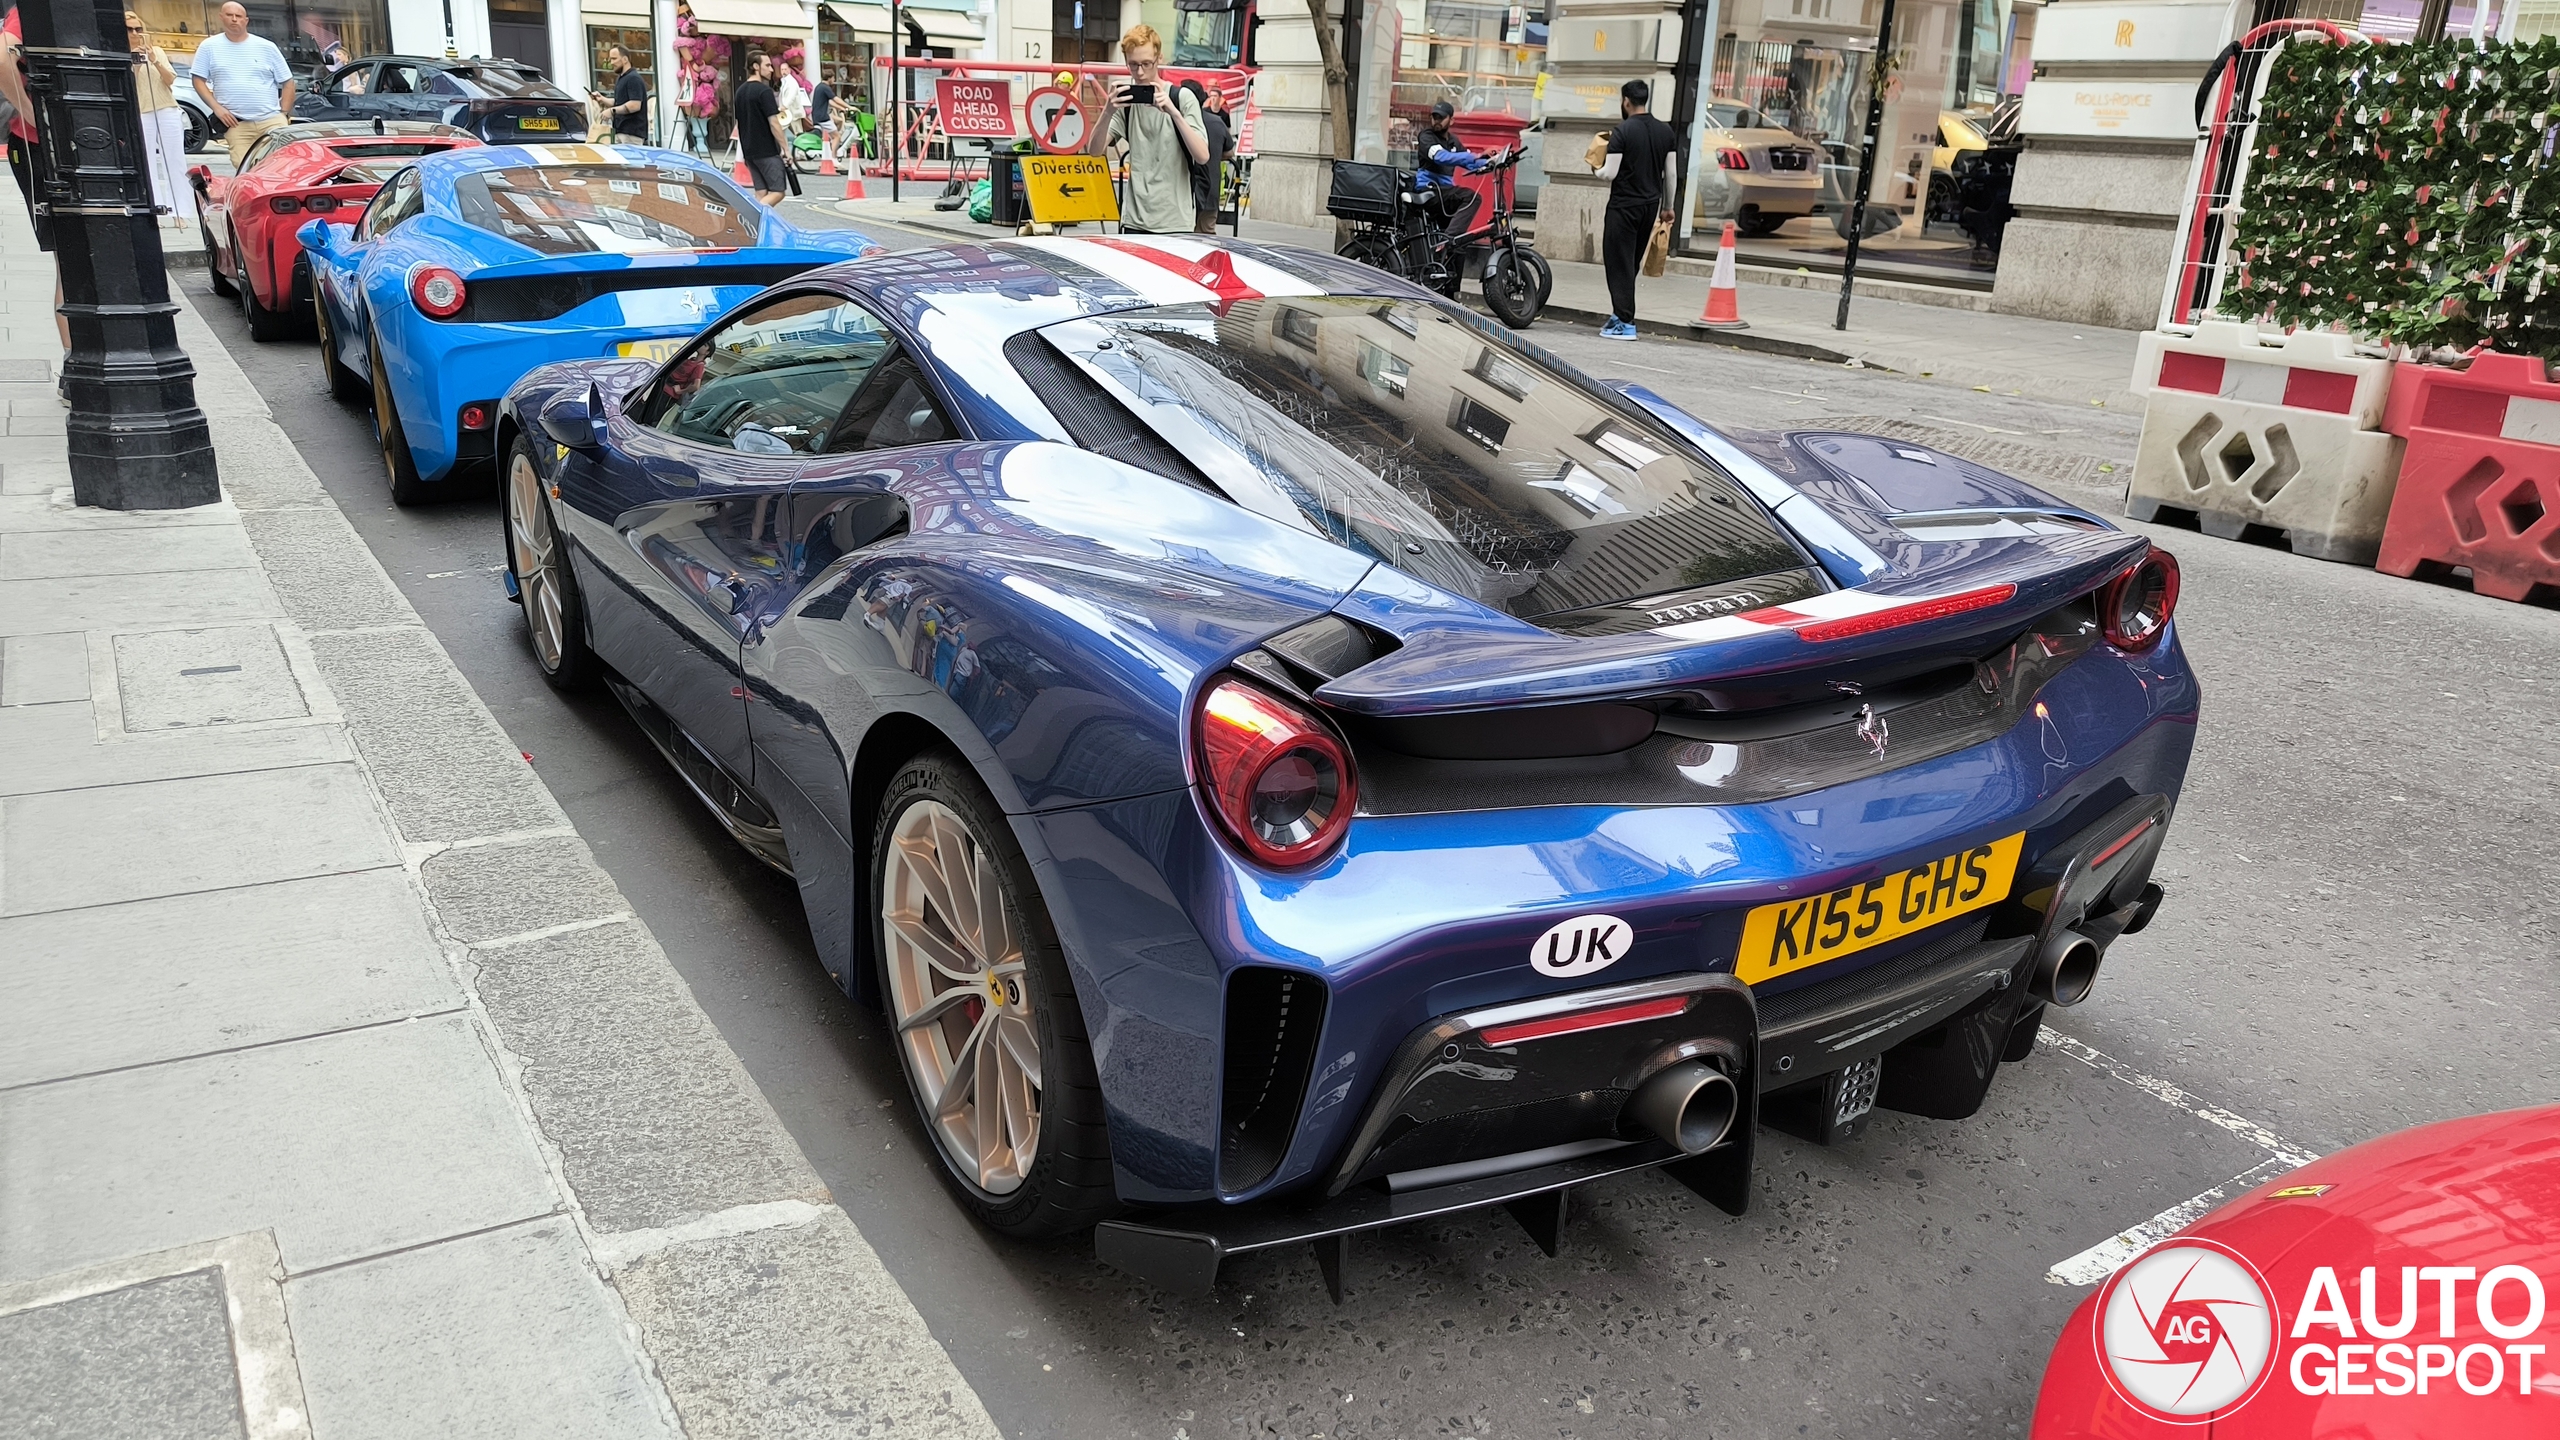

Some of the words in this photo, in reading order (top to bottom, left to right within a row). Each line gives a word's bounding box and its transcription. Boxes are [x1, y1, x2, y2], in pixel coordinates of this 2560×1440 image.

[1025, 42, 1041, 58] 12
[952, 85, 993, 100] ROAD
[953, 101, 999, 116] AHEAD
[951, 117, 1006, 130] CLOSED
[883, 770, 917, 813] MICHELIN
[1899, 845, 1993, 924] GHS
[1548, 924, 1618, 968] UK
